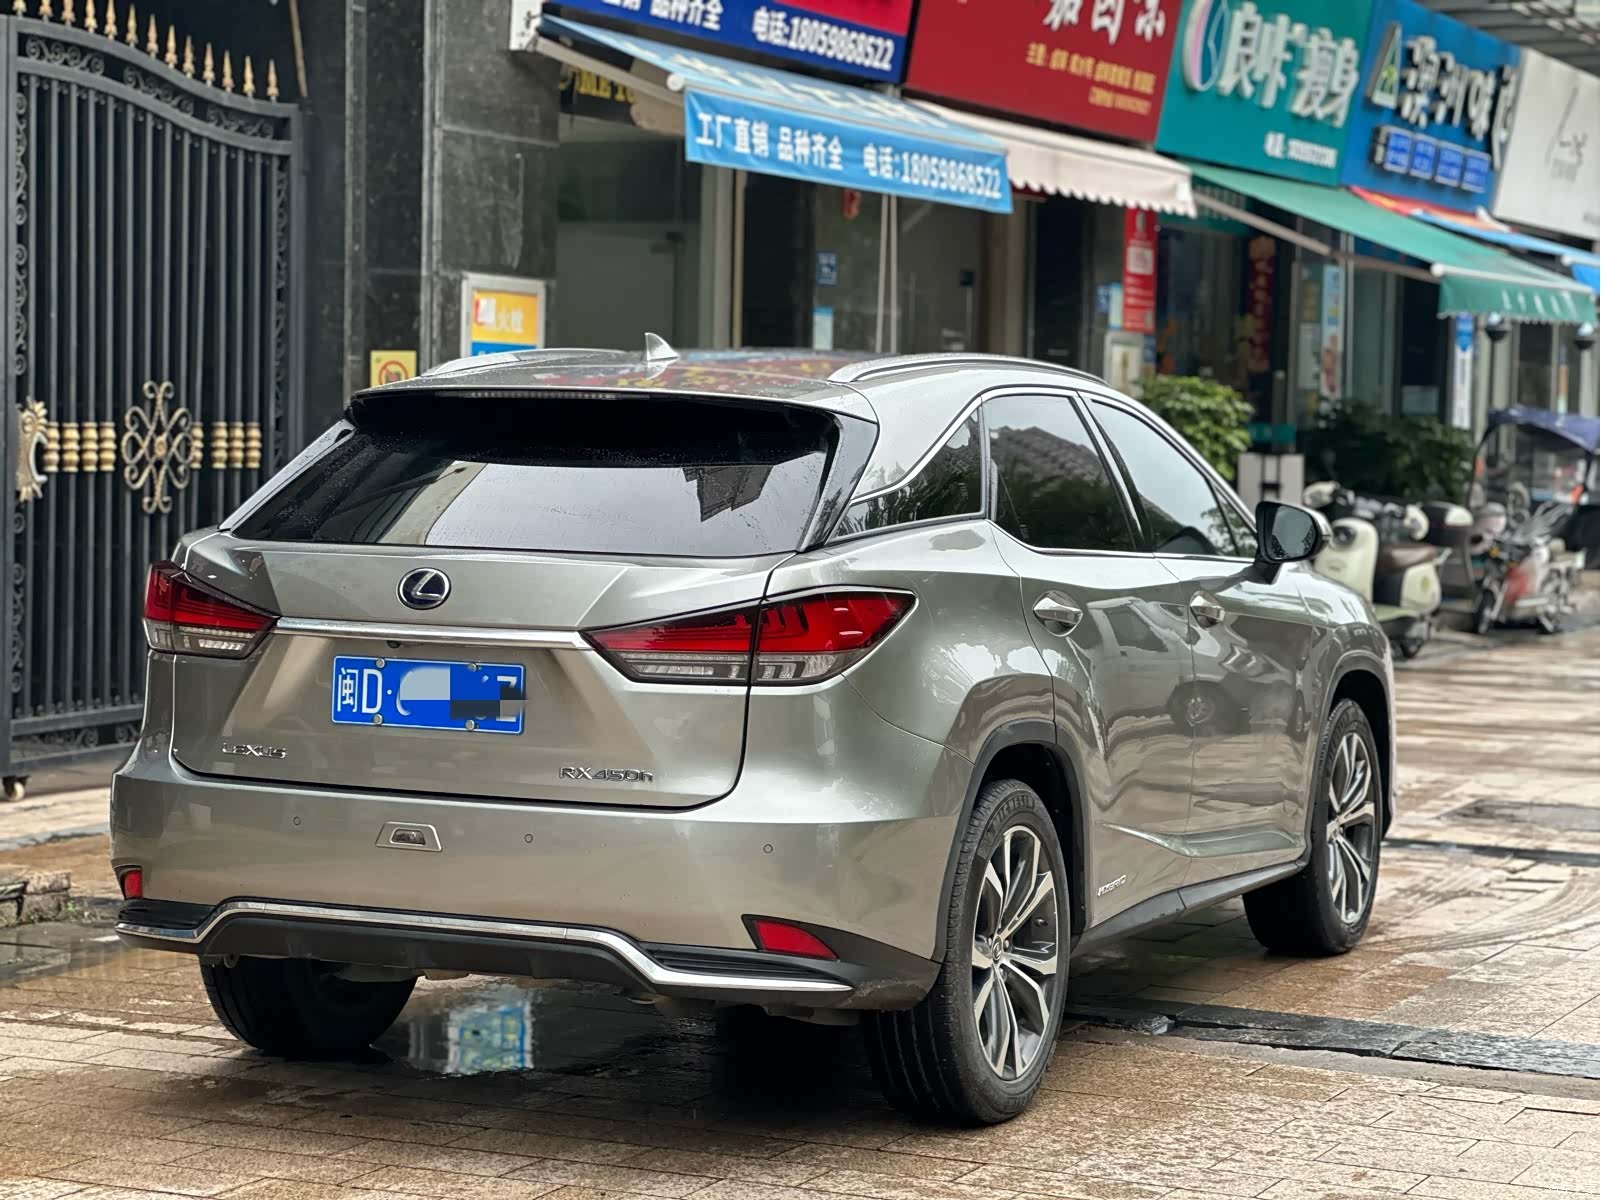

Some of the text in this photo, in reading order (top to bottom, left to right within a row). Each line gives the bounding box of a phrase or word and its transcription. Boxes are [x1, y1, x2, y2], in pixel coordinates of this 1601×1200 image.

[694, 111, 770, 158] 工厂直销
[776, 125, 844, 172] 品种齐全
[221, 742, 287, 759] LEXUS
